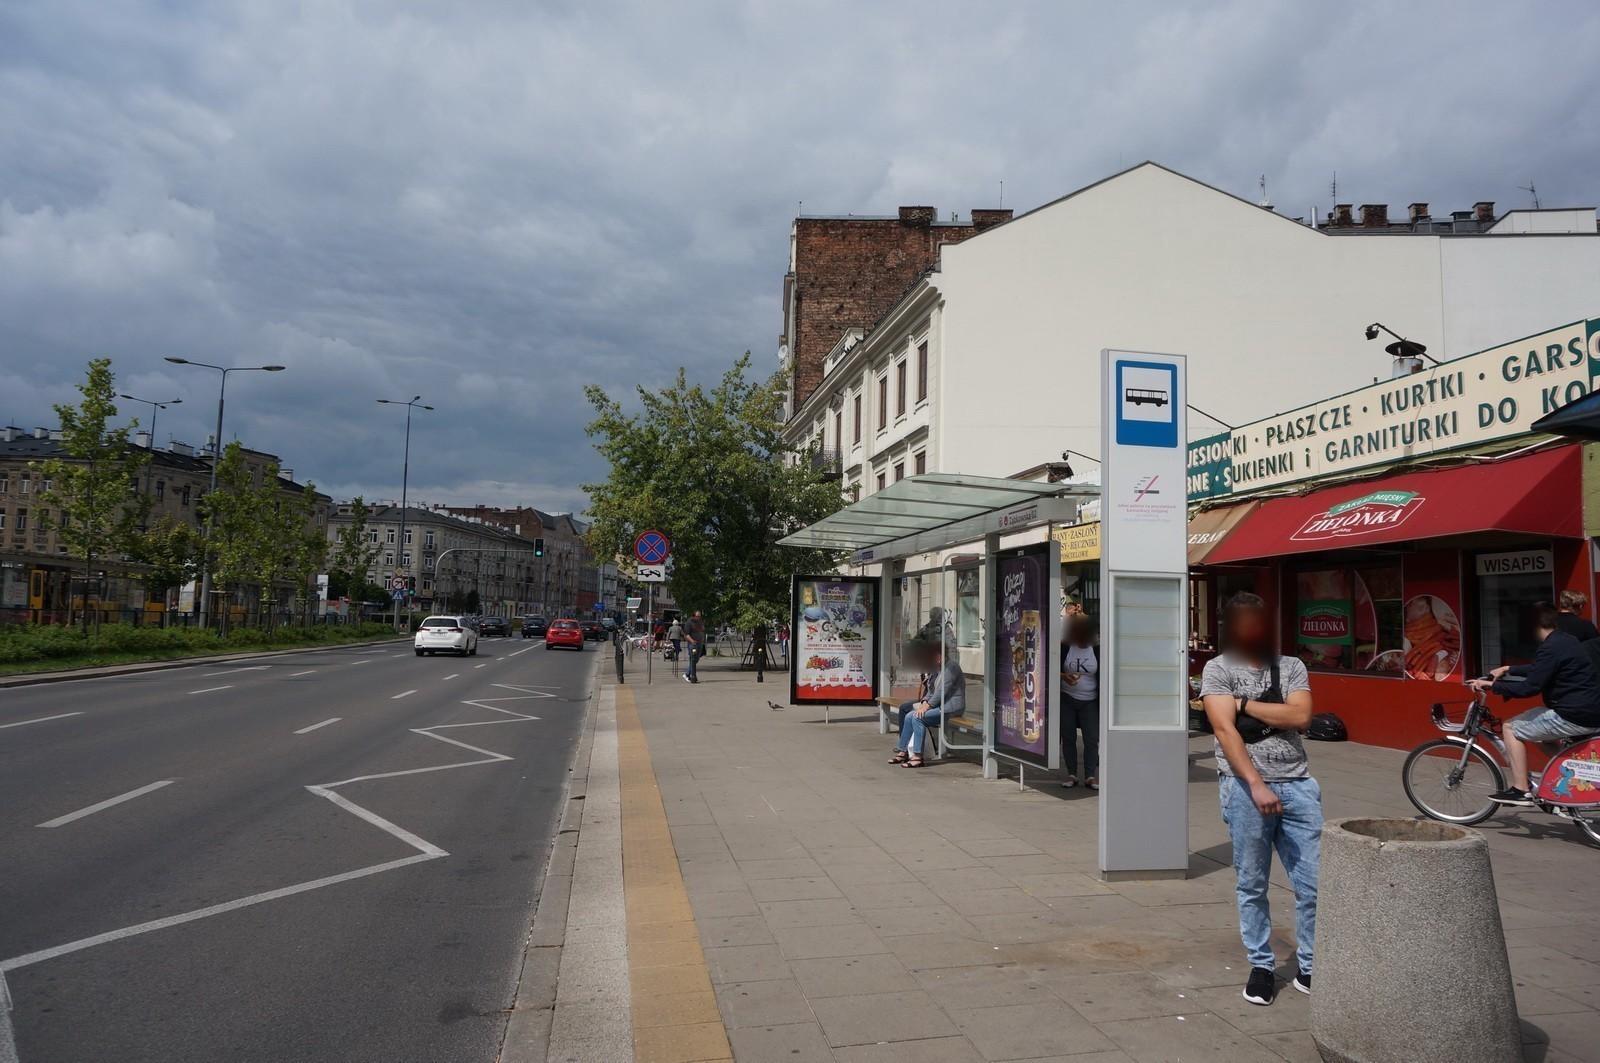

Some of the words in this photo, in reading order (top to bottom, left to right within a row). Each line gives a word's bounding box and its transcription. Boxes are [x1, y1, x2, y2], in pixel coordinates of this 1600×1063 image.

[1187, 434, 1247, 469] JESIONKI
[1266, 404, 1352, 447] PŁASZCZE
[1380, 371, 1464, 416] KURTKI
[1223, 451, 1294, 487] SUKIENKI
[1305, 447, 1311, 468] i
[1325, 410, 1458, 463] GARNITURKI
[1478, 397, 1517, 428] DO
[1303, 508, 1403, 534] ZIELONKA
[1484, 555, 1546, 573] WISAPIS
[1303, 621, 1345, 632] ZIELONKA
[1024, 625, 1036, 736] TIGER
